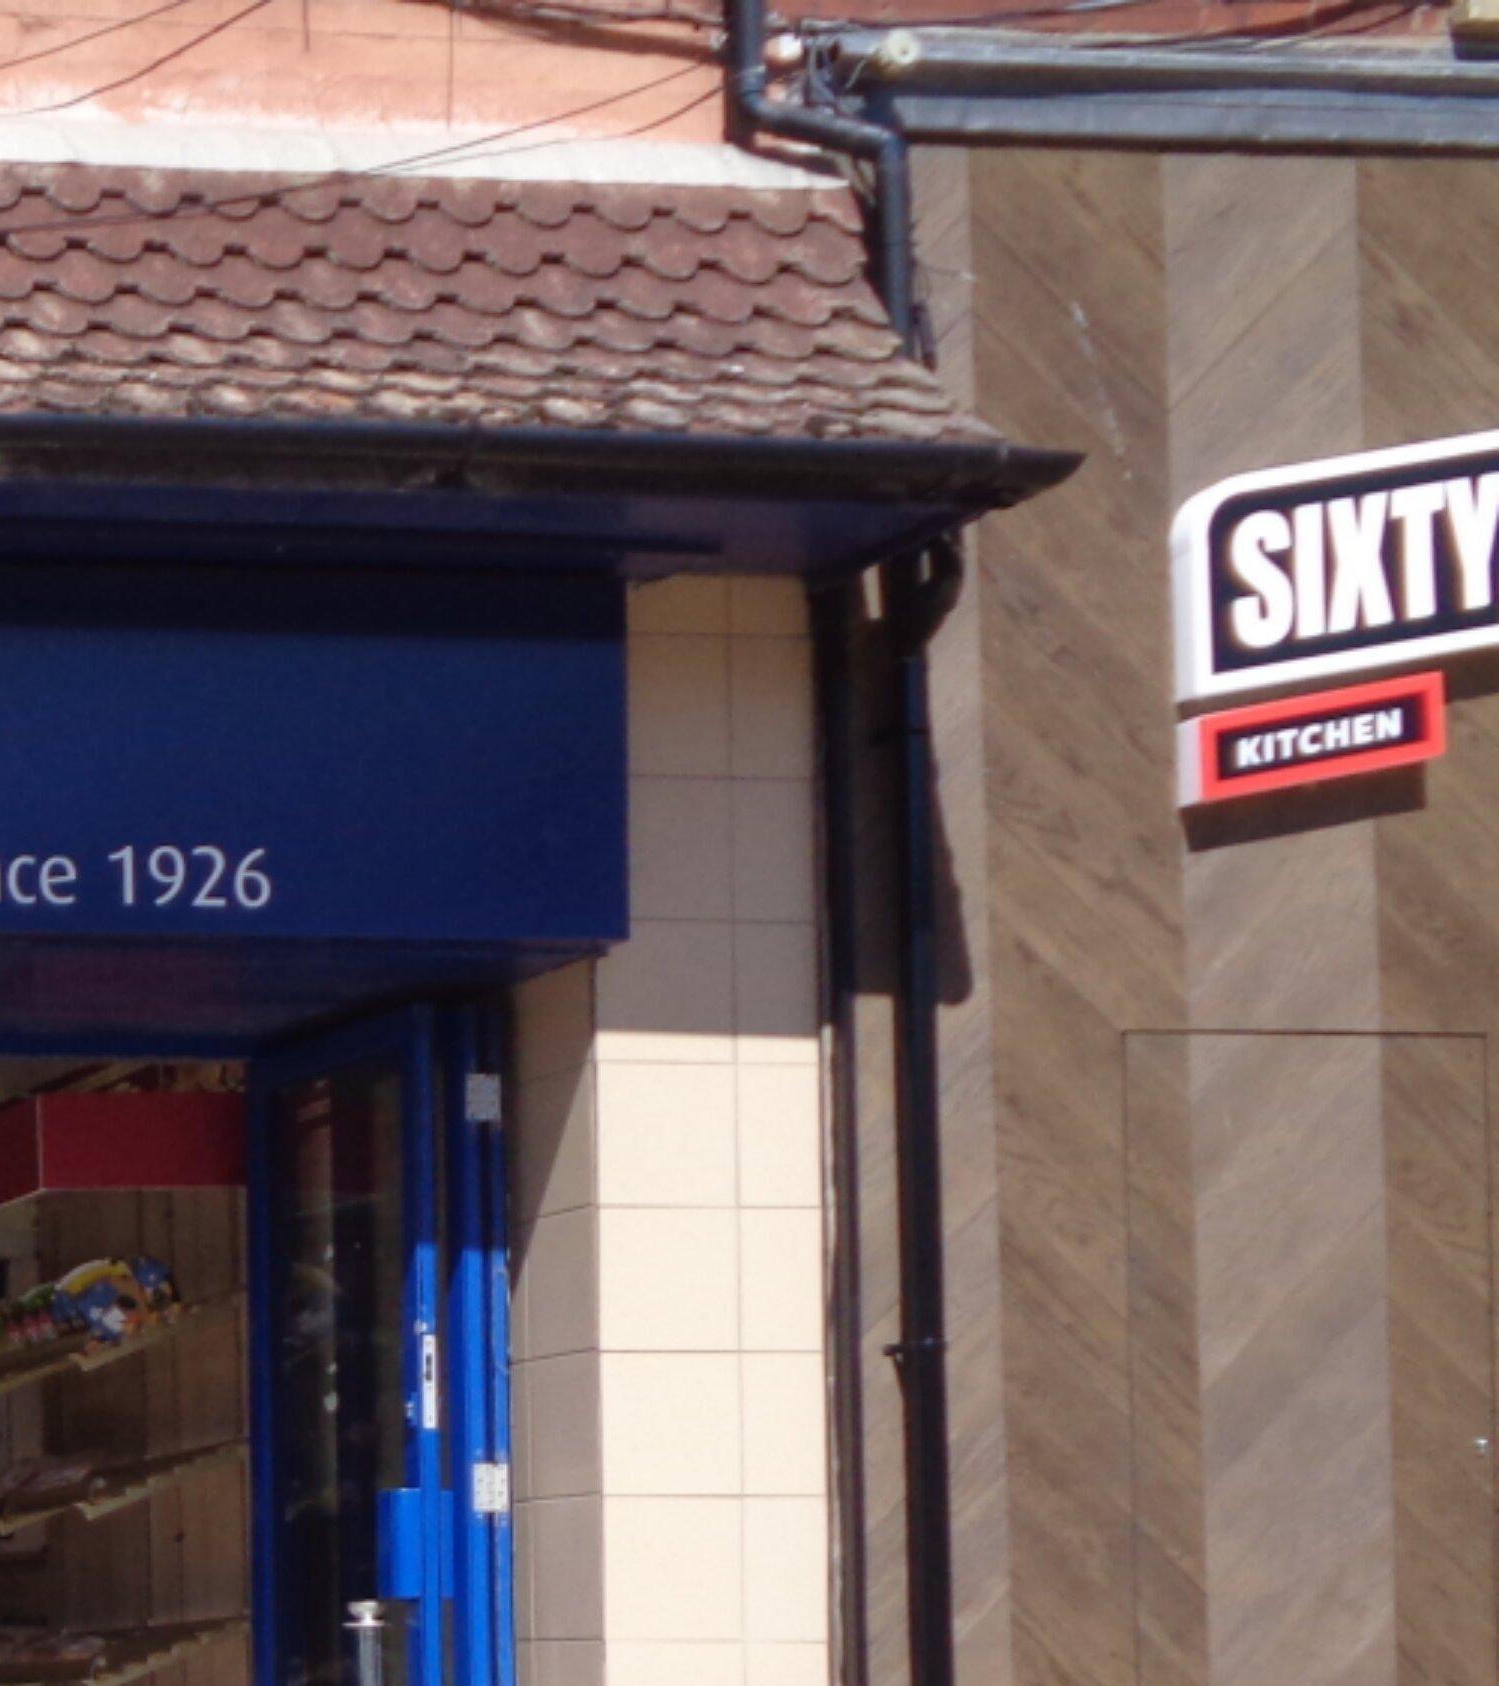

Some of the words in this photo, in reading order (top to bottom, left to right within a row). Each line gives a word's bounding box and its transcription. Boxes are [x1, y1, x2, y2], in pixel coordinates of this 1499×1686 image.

[1231, 471, 1499, 649] SIXTY
[1234, 707, 1404, 770] KITCHEN
[107, 844, 272, 909] 1926
